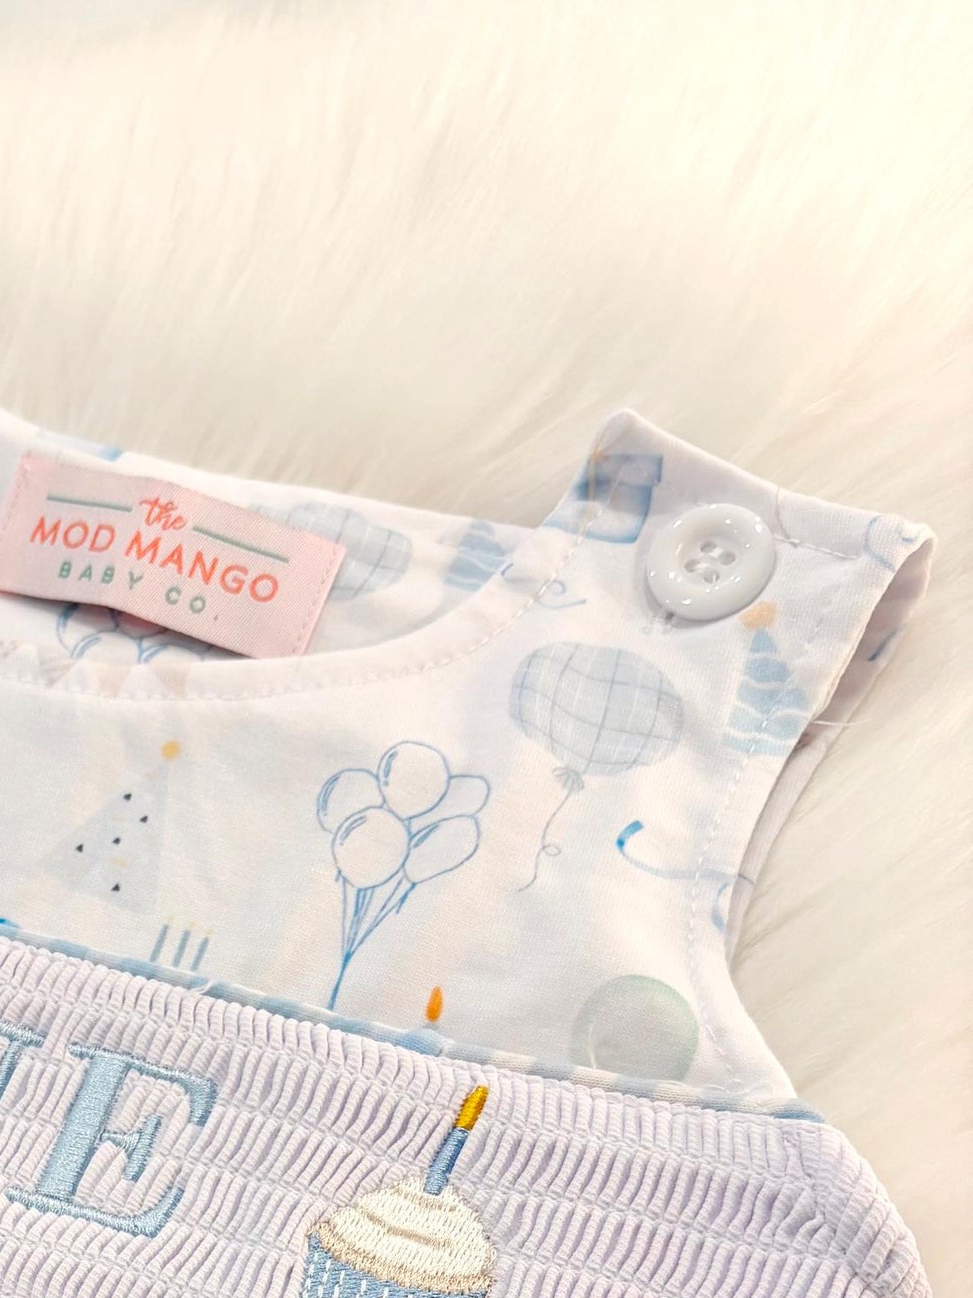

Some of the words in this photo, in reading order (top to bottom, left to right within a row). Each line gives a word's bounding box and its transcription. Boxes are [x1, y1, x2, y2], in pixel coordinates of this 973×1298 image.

[138, 496, 188, 532] the
[30, 516, 117, 553] MOD
[124, 530, 279, 603] MANGO
[58, 560, 144, 591] BABY
[165, 586, 220, 622] CO.
